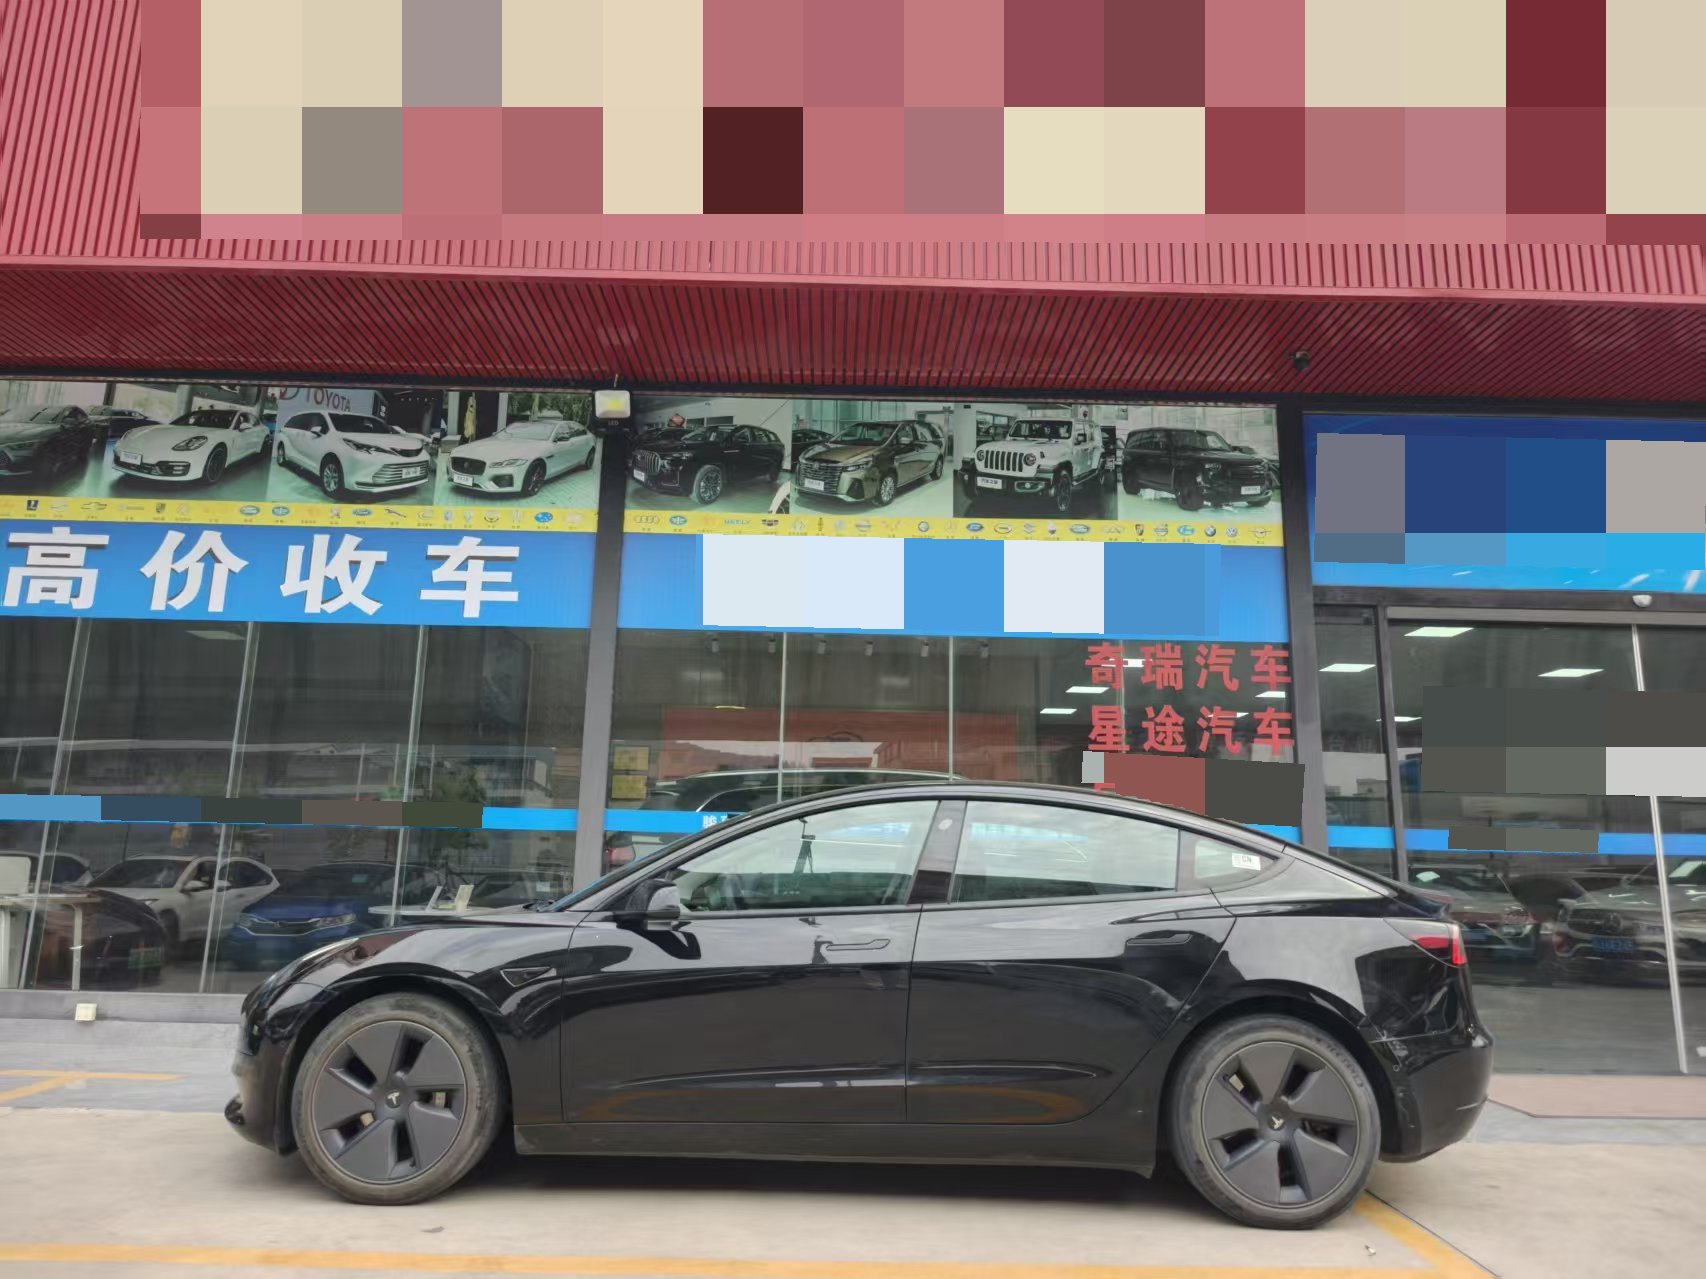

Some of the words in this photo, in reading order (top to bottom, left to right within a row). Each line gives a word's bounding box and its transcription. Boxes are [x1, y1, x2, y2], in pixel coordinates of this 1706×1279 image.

[3, 527, 520, 619] 高价收车
[1084, 642, 1292, 693] 奇瑞汽车
[1087, 704, 1295, 756] 星途汽车
